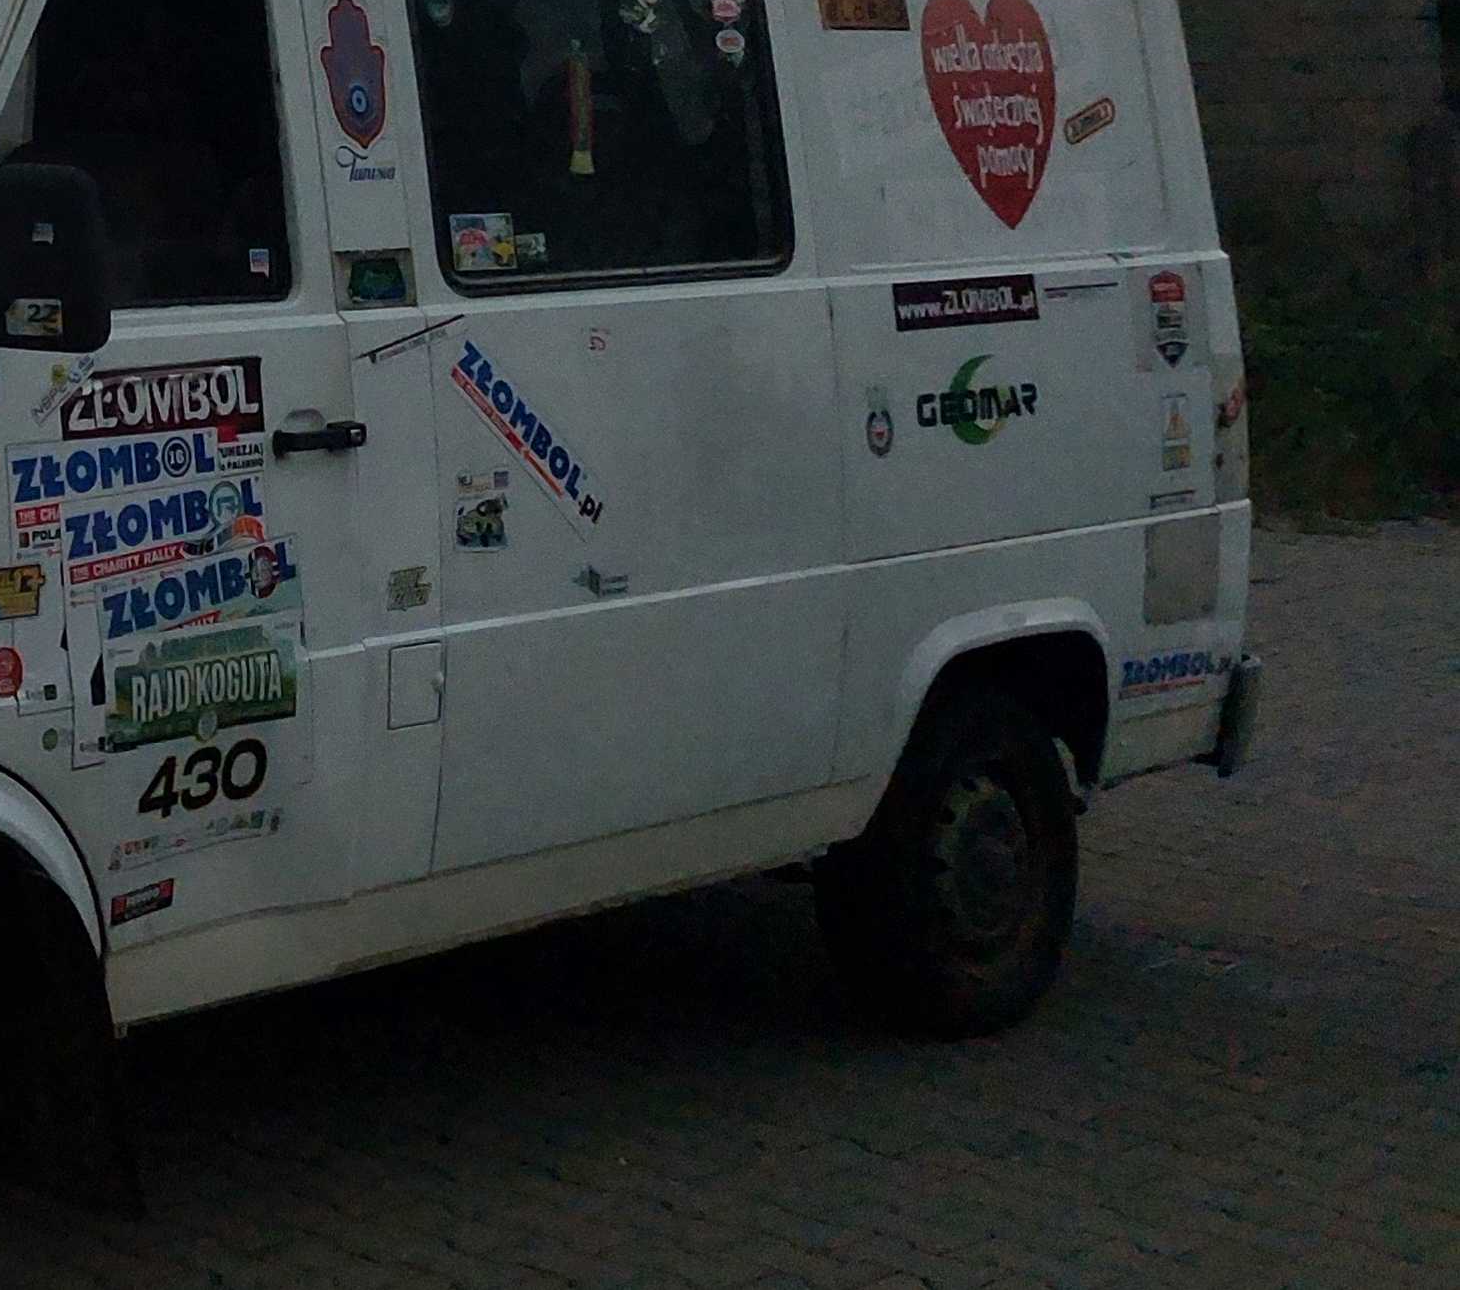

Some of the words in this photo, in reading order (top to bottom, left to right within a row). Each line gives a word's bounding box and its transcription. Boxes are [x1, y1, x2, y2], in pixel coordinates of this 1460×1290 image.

[67, 364, 261, 432] ZŁOMBOL
[457, 340, 604, 525] ZŁOMBOL.pl
[917, 382, 1038, 427] GEOMAR
[12, 433, 215, 503] ZŁOMBOL
[19, 510, 36, 521] THE
[66, 479, 262, 559] ZŁOMBOL
[93, 557, 143, 577] CHARITY
[144, 545, 178, 566] RALLY
[103, 542, 296, 639] ZŁOMBOL
[132, 668, 189, 722] RAJD
[196, 653, 283, 706] KOGUTA
[139, 738, 268, 818] 430
